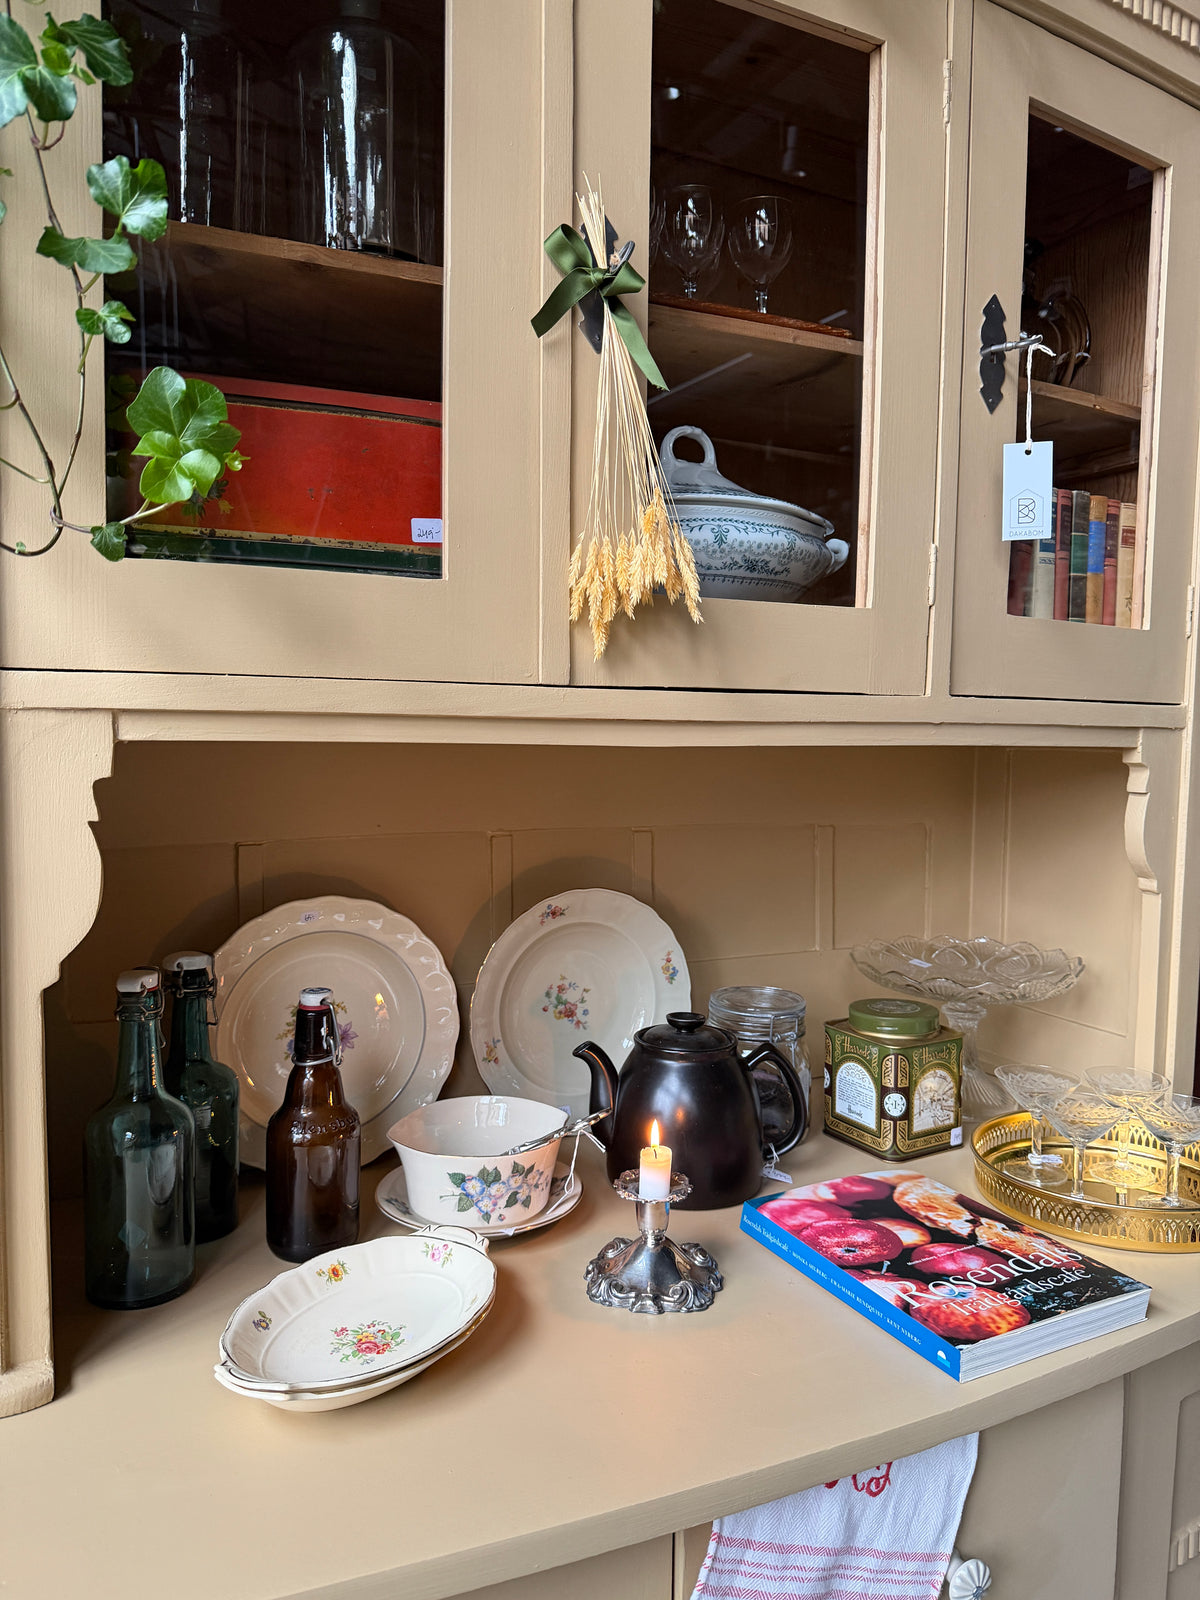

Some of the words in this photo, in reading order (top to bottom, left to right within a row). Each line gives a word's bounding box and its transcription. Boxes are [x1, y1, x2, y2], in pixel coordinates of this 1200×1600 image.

[1009, 529, 1044, 537] DAKABOM
[882, 1242, 1083, 1309] Rosendals
[943, 1267, 1092, 1316] Trädgårdscafé
